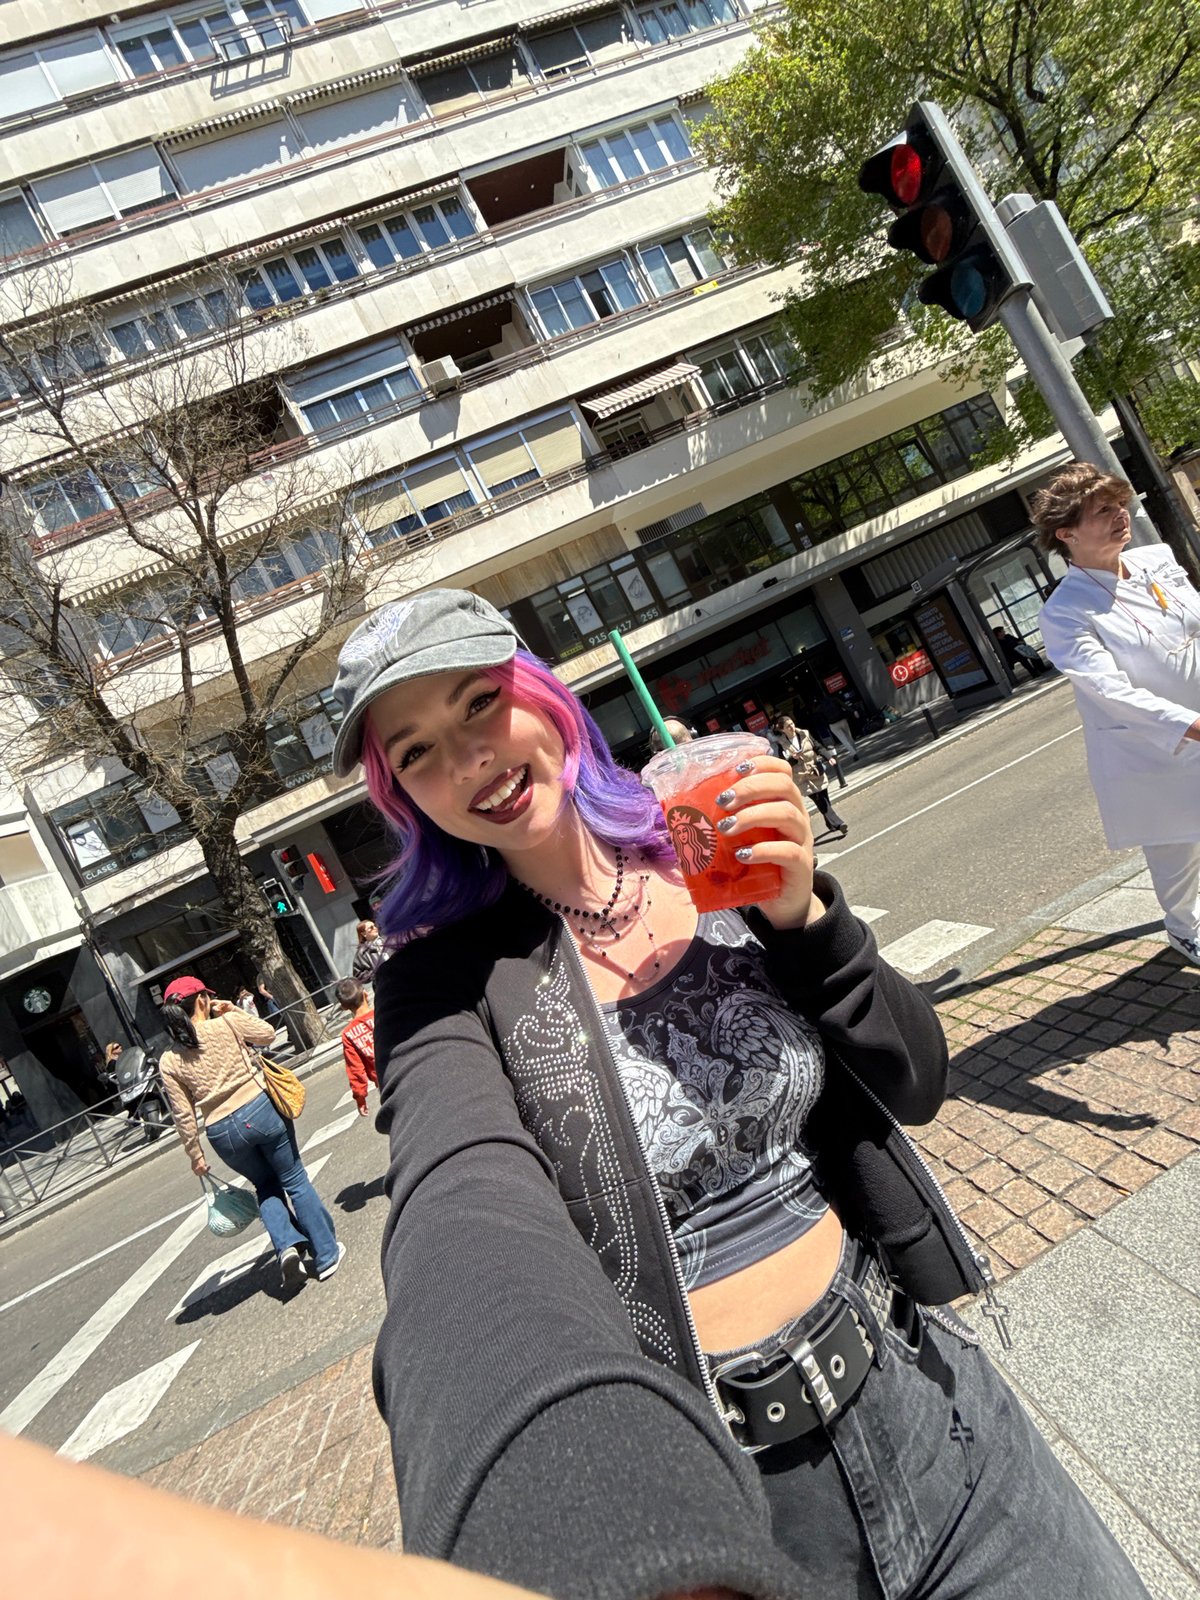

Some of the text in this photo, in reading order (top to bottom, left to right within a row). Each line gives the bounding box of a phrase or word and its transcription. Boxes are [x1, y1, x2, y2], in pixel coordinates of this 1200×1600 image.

[588, 631, 607, 646] 915
[640, 608, 659, 624] 255
[85, 861, 118, 880] CLASES
